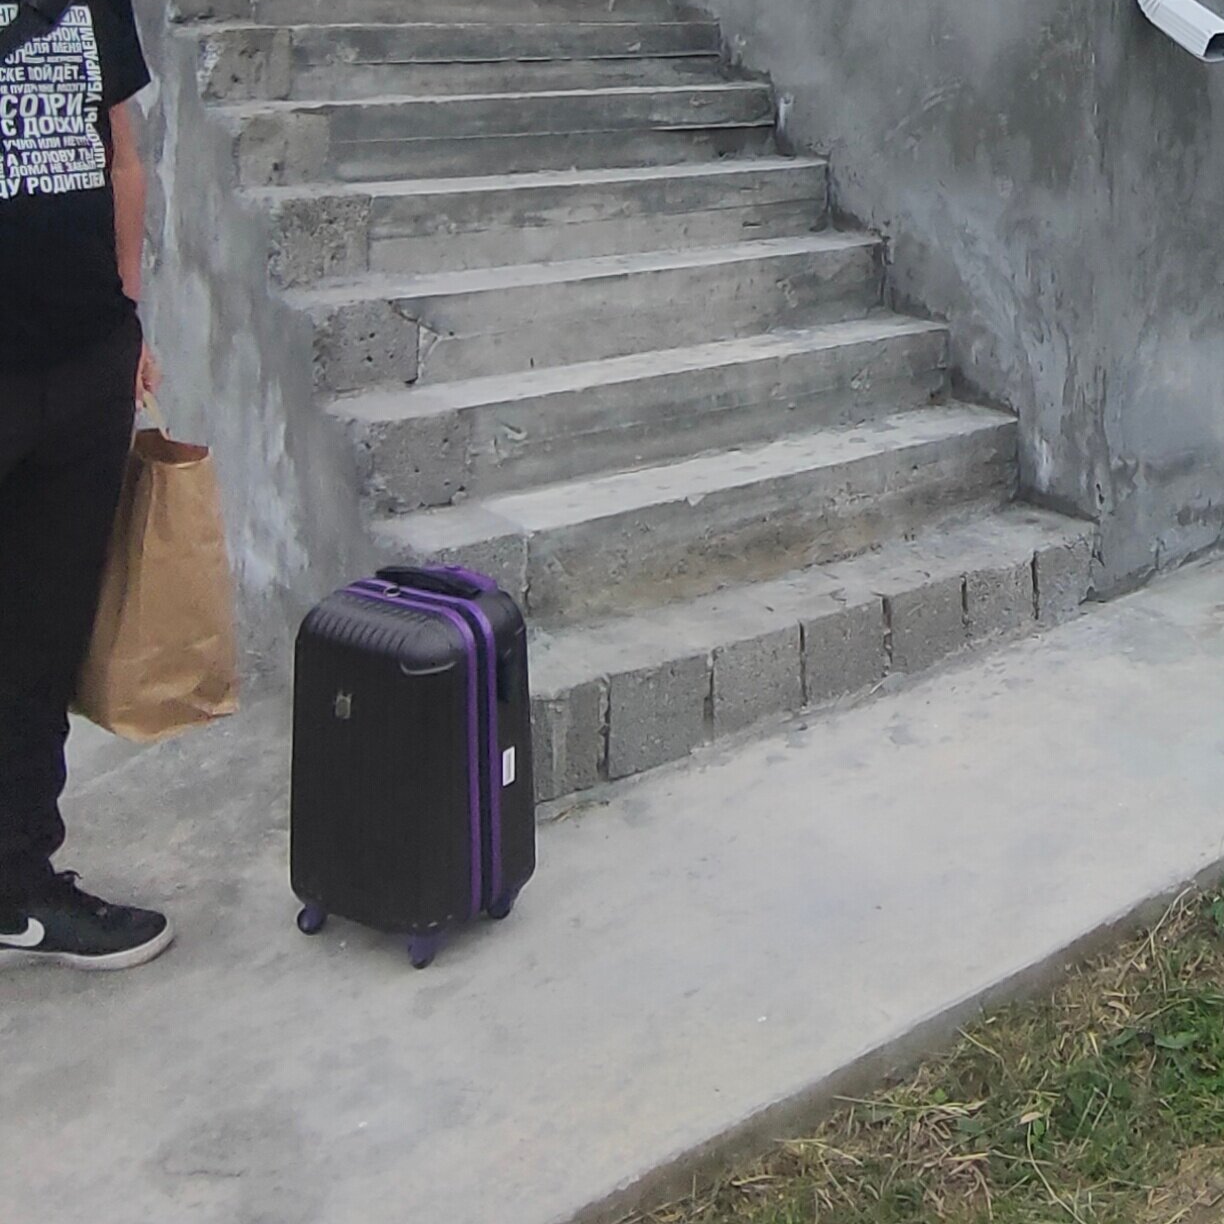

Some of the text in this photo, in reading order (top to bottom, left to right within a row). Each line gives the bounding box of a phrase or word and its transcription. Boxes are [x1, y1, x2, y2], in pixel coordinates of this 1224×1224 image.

[0, 67, 25, 82] СКЕ
[79, 27, 103, 103] УБИРАЕМ
[0, 93, 83, 118] СОТРИ
[1, 119, 17, 136] С
[7, 153, 19, 167] А
[21, 148, 76, 166] ГОЛОВУ
[10, 163, 48, 178] ДОМА
[0, 177, 20, 200] ДУ
